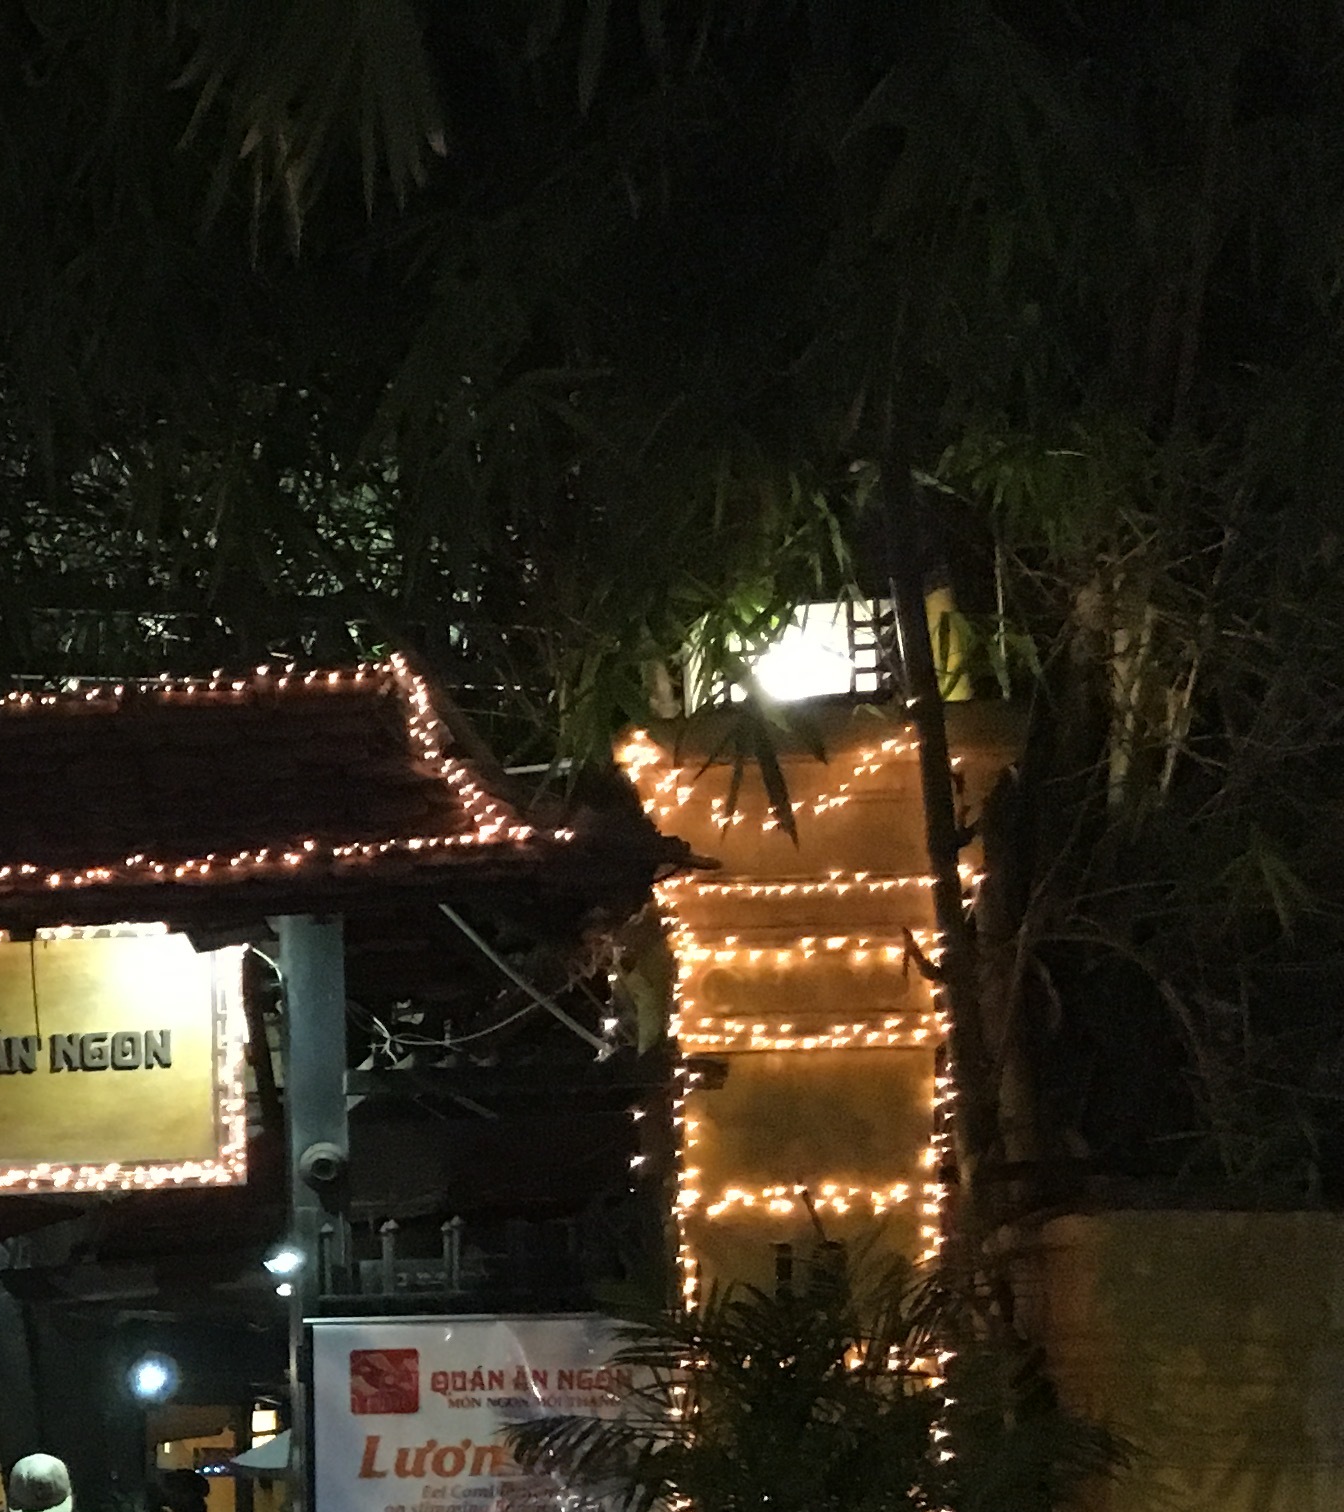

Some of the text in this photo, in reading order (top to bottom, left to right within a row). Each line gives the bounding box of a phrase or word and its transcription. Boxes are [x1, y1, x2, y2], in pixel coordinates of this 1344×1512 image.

[49, 1030, 172, 1073] NGON
[431, 1366, 504, 1394] QUÁN
[358, 1435, 506, 1478] Lươn
